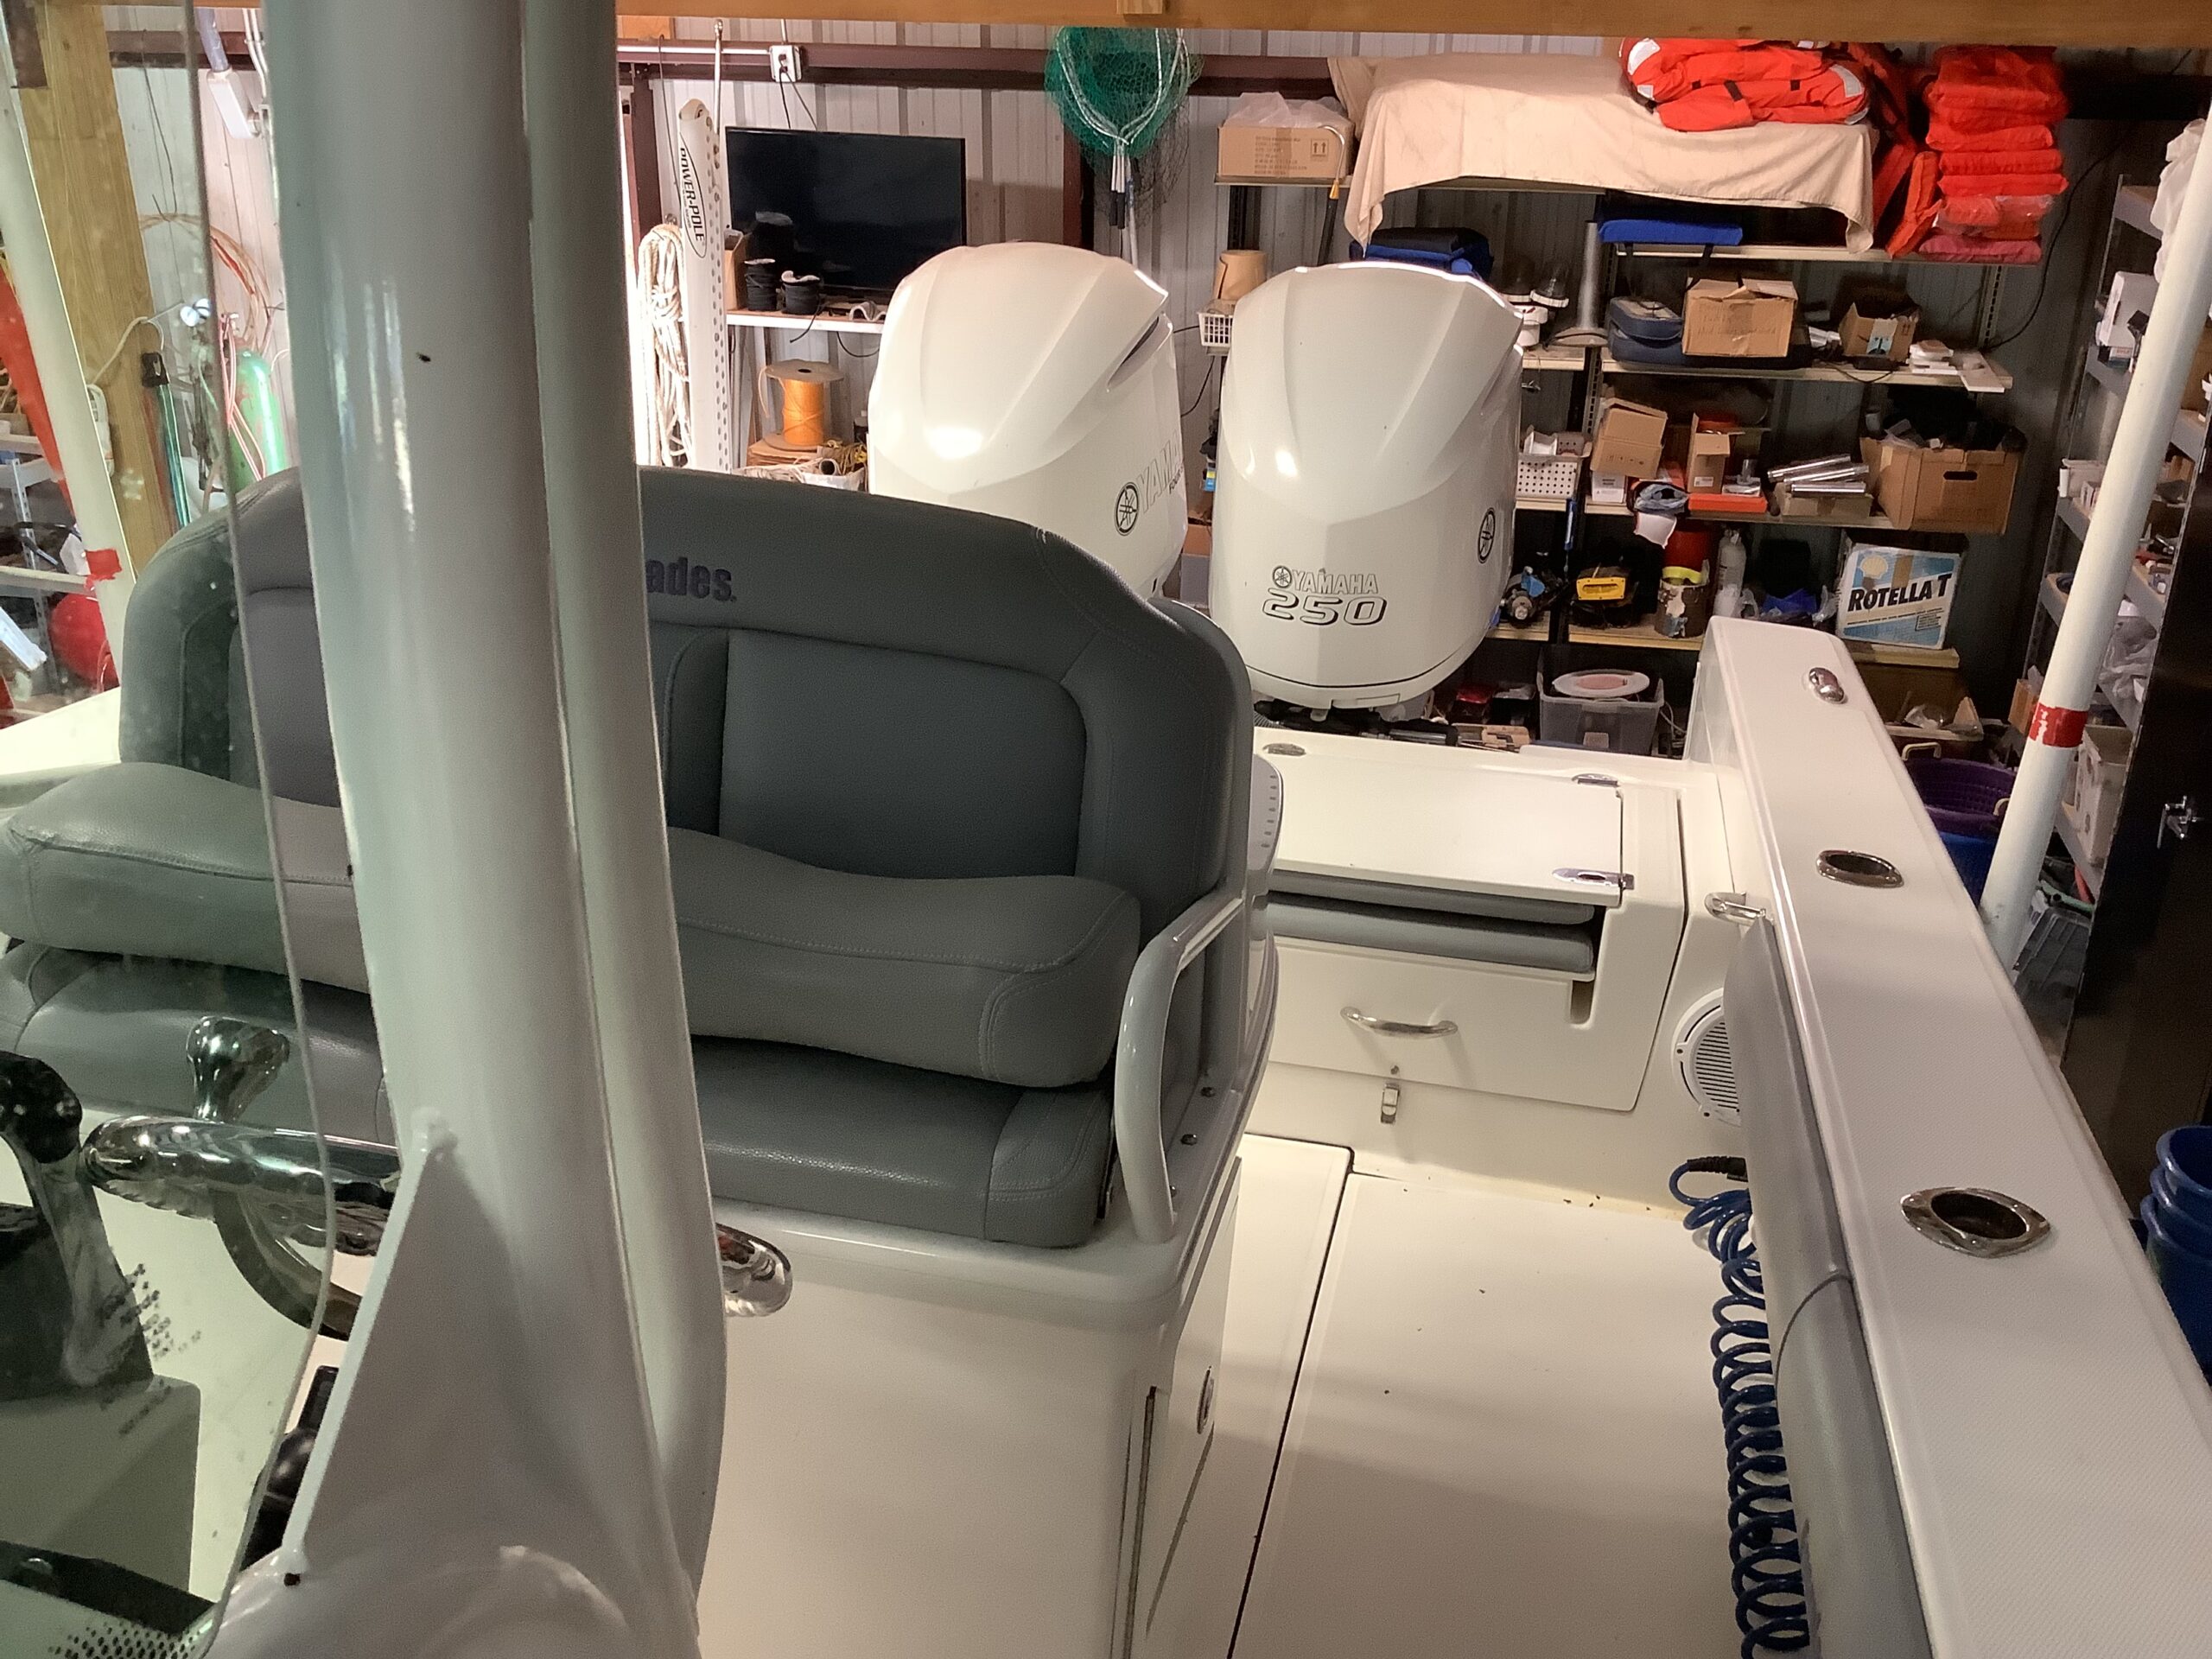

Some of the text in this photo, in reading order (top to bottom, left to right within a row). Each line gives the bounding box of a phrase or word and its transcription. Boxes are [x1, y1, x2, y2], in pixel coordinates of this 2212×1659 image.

[680, 147, 705, 242] POWER-POLE
[1292, 569, 1379, 594] YAMAHA
[1847, 572, 1953, 613] ROTELLA T
[1262, 588, 1388, 626] 250
